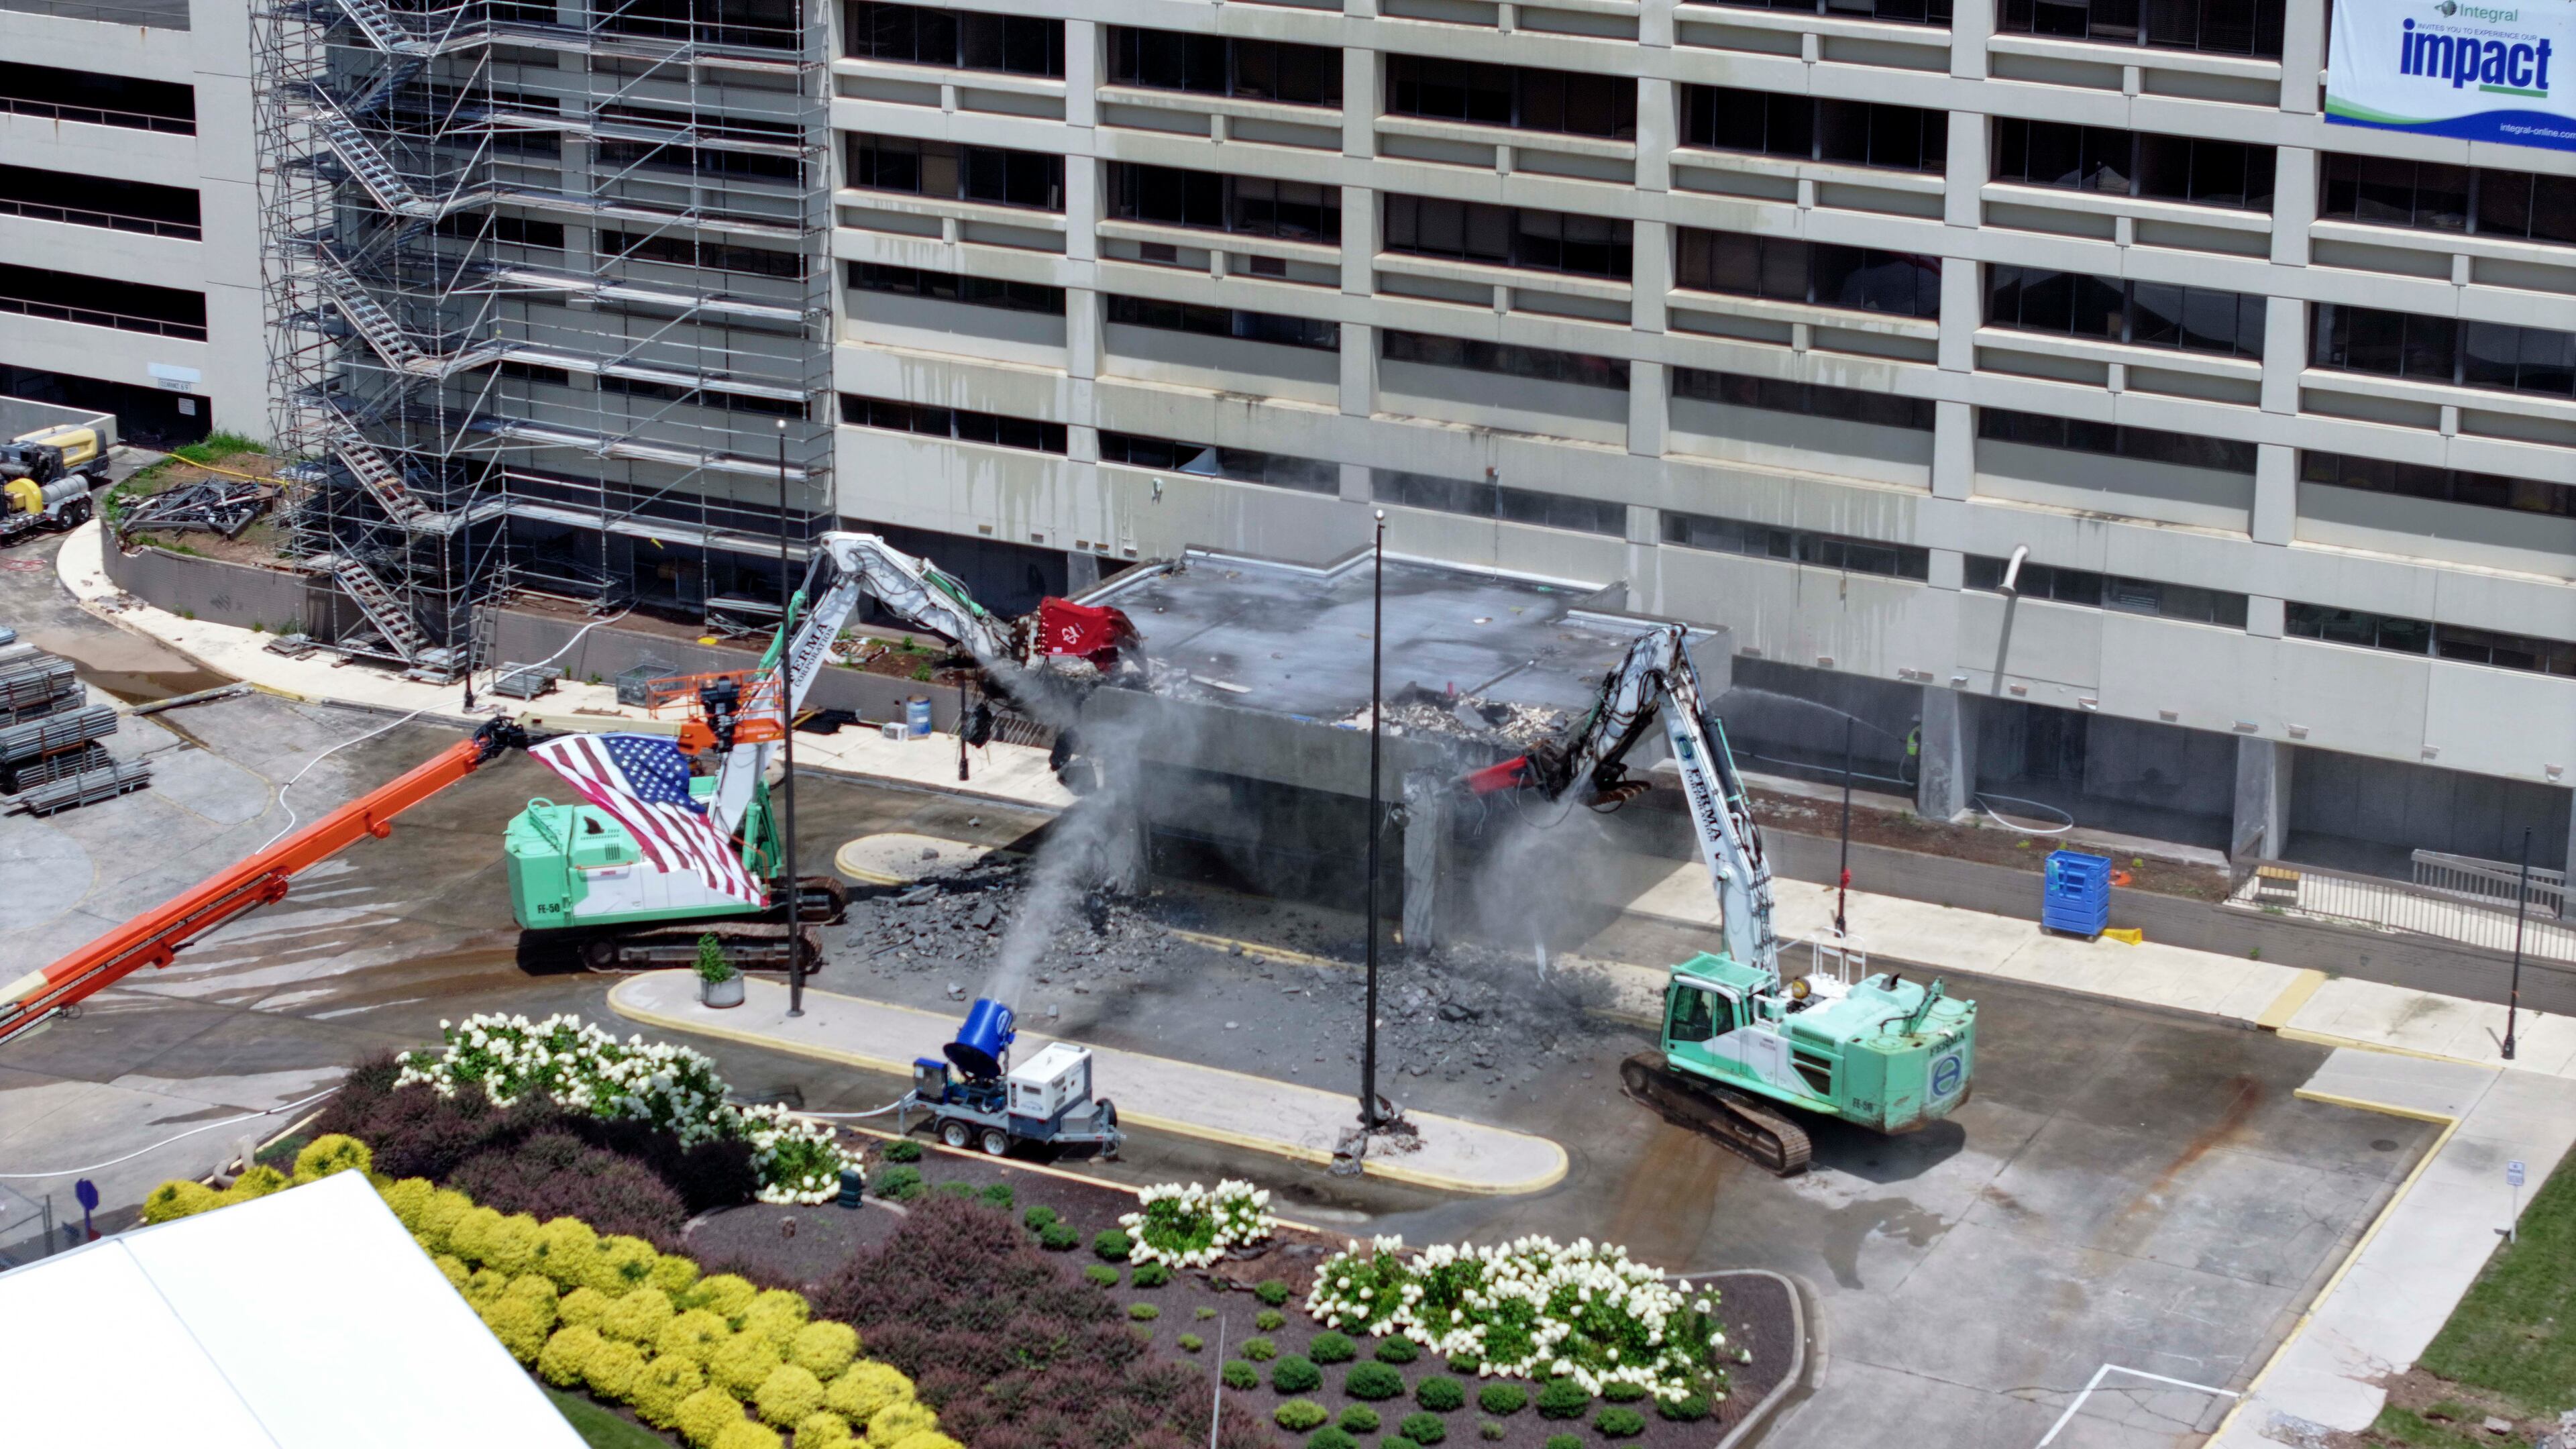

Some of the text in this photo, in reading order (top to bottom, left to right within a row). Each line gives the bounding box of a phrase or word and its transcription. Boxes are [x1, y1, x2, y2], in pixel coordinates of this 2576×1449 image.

[2417, 22, 2445, 32] INVITES
[2447, 25, 2461, 34] YOU
[2474, 29, 2520, 40] EXPERIENCE
[2460, 4, 2518, 23] Integral
[2400, 18, 2552, 89] impact
[794, 626, 835, 687] CORPORATION
[1686, 769, 1717, 843] CORPORATION
[1690, 767, 1722, 841] FERMA
[537, 904, 560, 914] FE-50
